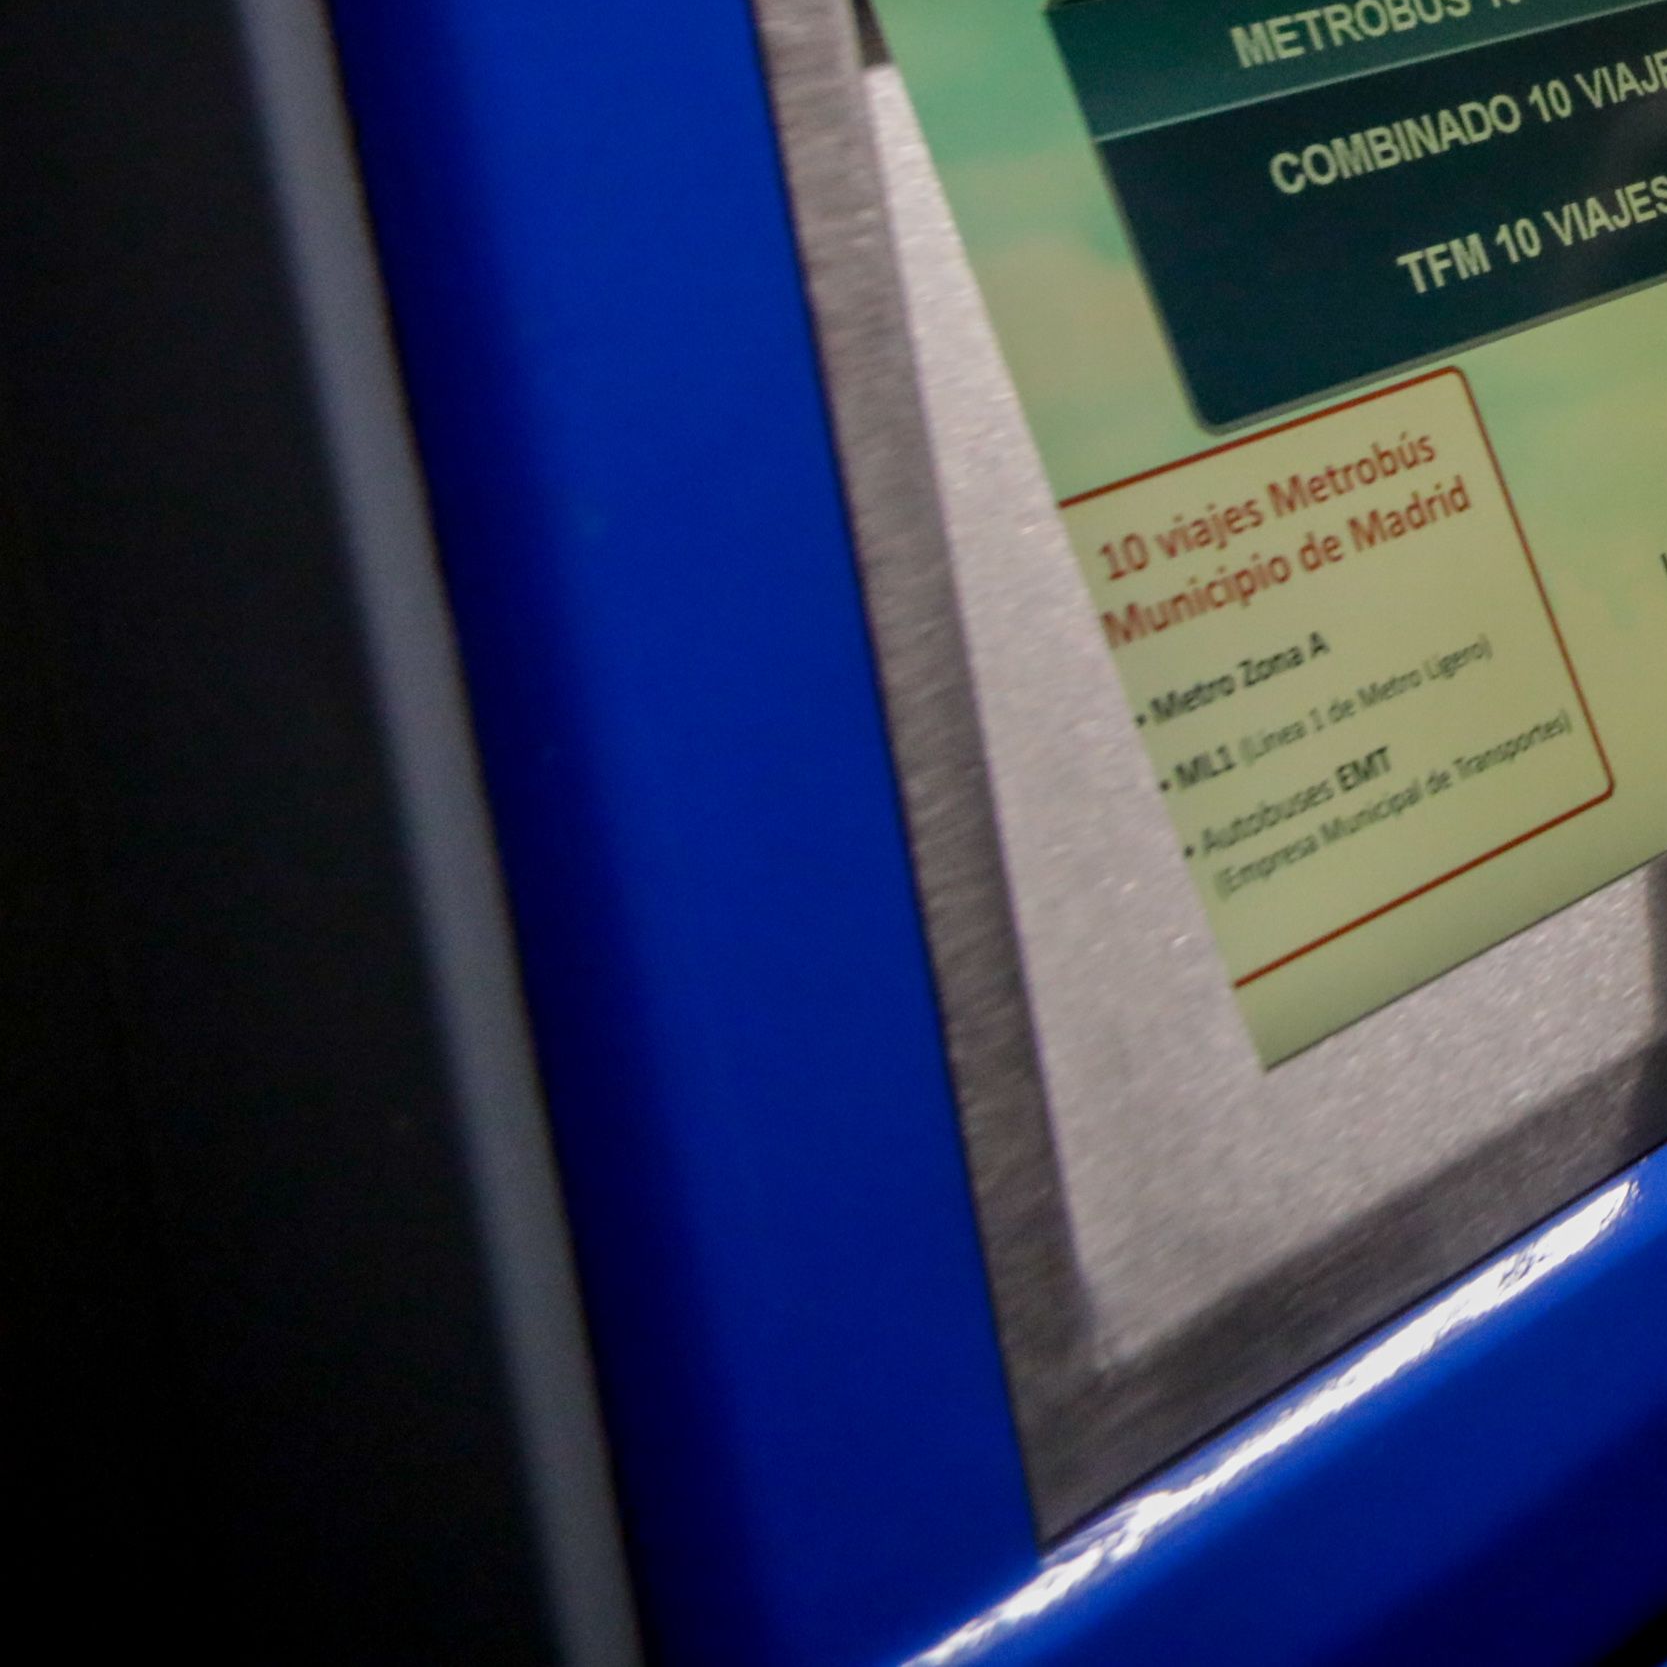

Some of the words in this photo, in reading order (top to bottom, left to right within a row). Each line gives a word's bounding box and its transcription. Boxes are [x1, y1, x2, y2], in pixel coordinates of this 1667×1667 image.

[1270, 94, 1521, 194] COMBINADO
[1528, 79, 1573, 122] 10
[1396, 233, 1491, 294] TFM
[1494, 218, 1541, 263] 10
[1099, 532, 1151, 581] 10
[1155, 497, 1264, 559] viajes
[1267, 432, 1437, 519] Metrobús
[1101, 553, 1292, 649] Municipio
[1299, 532, 1344, 574] de
[1347, 475, 1472, 553] Madrid
[1150, 673, 1236, 724] Metro
[1237, 644, 1306, 688] Zona
[1308, 631, 1331, 659] A
[1328, 697, 1356, 724] de
[1356, 669, 1423, 708] Metro
[1202, 778, 1335, 858] Autobuses
[1336, 745, 1391, 793] EMT
[1320, 777, 1422, 846] Municipal
[1425, 769, 1453, 797] de
